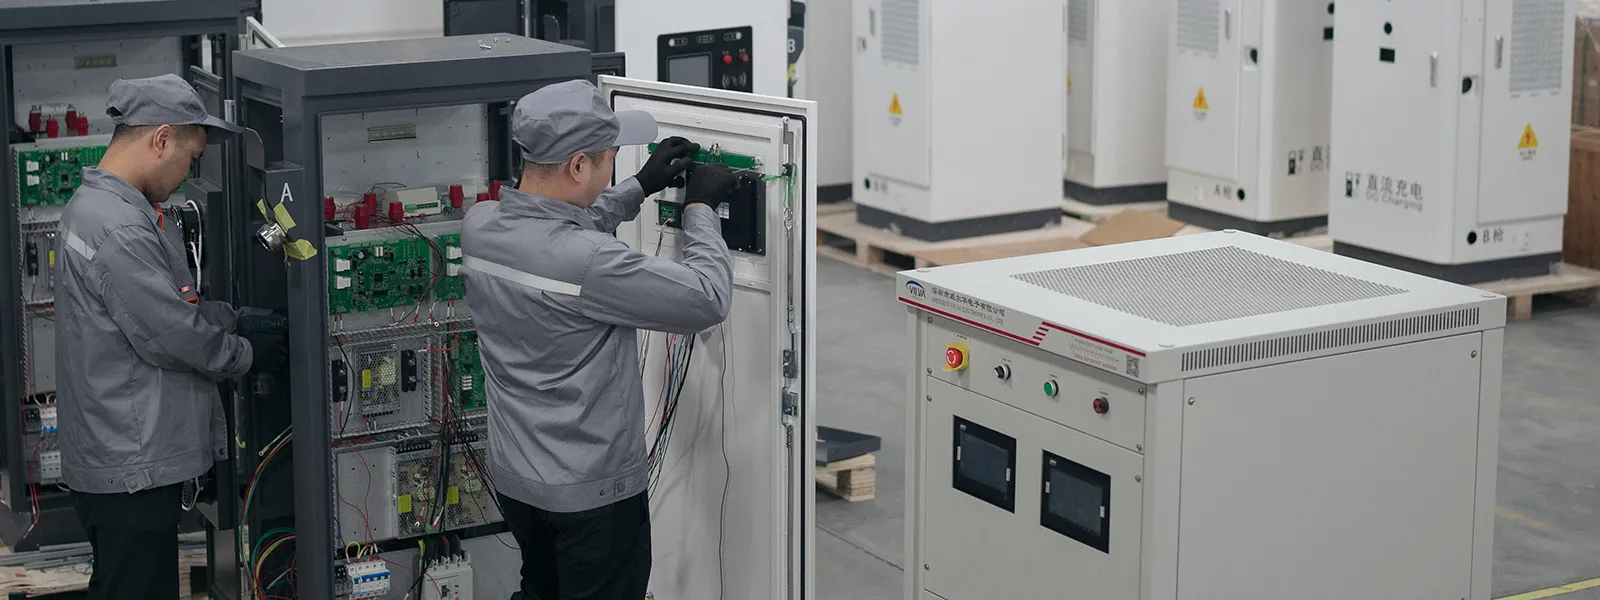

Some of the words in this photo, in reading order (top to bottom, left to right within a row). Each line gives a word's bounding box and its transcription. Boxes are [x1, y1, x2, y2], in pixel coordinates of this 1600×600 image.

[788, 38, 796, 53] B
[280, 182, 293, 203] A
[1366, 173, 1423, 201] 直流充电
[1382, 193, 1422, 213] Charging
[909, 285, 926, 299] VILVA
